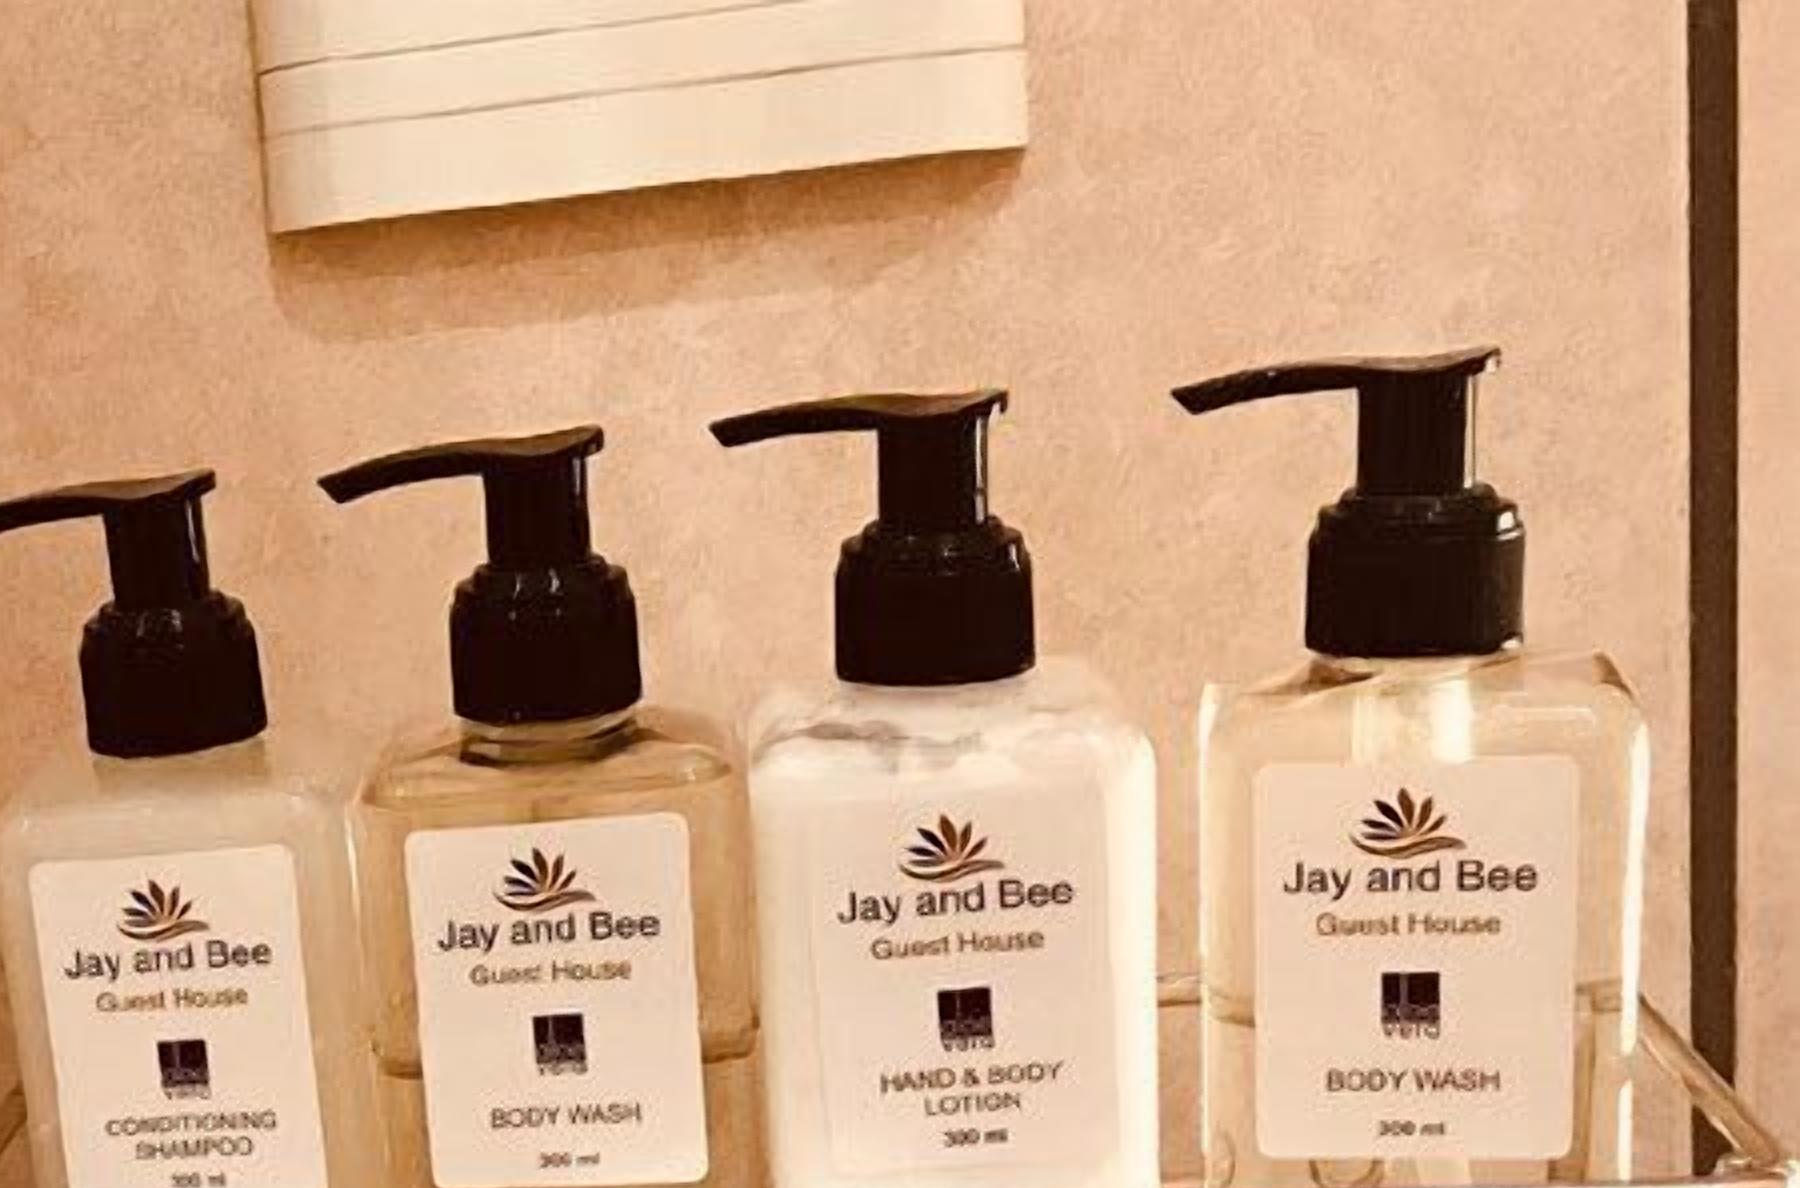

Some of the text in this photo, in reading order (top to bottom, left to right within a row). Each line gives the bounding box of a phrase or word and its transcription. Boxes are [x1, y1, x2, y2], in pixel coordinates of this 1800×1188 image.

[1284, 860, 1538, 900] Jay and Bee
[837, 879, 1074, 926] Jay and Bee
[438, 911, 660, 954] Jay and Bee
[1316, 911, 1502, 937] Guest House
[871, 927, 1046, 961] Guest House
[64, 938, 273, 981] Jay and Bee
[469, 959, 632, 987] Guest House
[96, 984, 249, 1012] Guest House
[880, 1059, 1065, 1095] HAND & BODY
[1326, 1067, 1501, 1092] BODY WASH
[491, 1102, 642, 1129] BODY WASH
[924, 1093, 1021, 1116] LOTION
[105, 1109, 277, 1136] CONDITIONING
[136, 1136, 253, 1160] SHAMPOO
